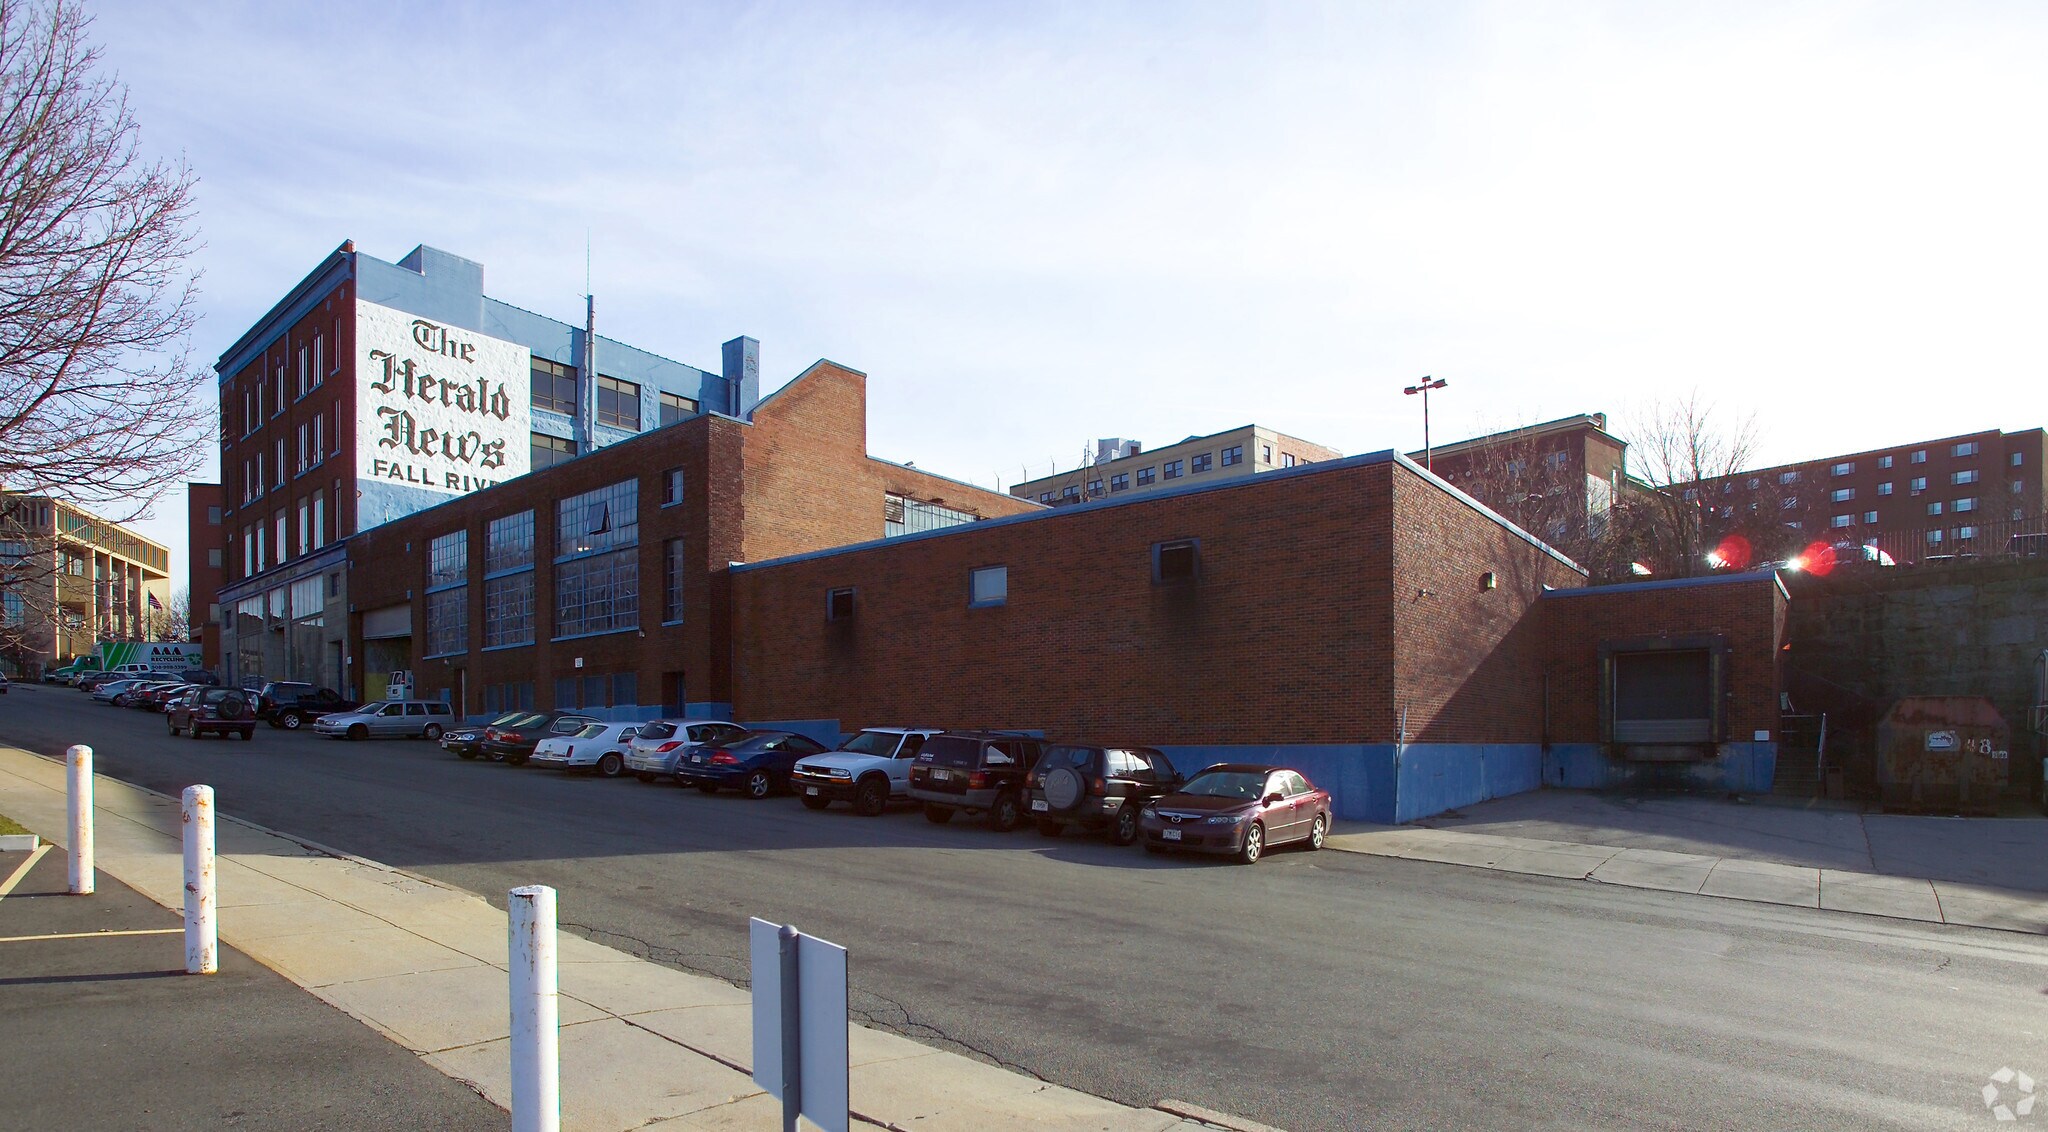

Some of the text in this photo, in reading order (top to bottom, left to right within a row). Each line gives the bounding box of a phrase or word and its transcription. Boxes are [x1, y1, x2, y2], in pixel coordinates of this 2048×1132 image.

[412, 319, 476, 364] The
[370, 349, 511, 422] Herald
[377, 406, 506, 470] News
[373, 459, 435, 486] FALL
[151, 646, 182, 655] AAA
